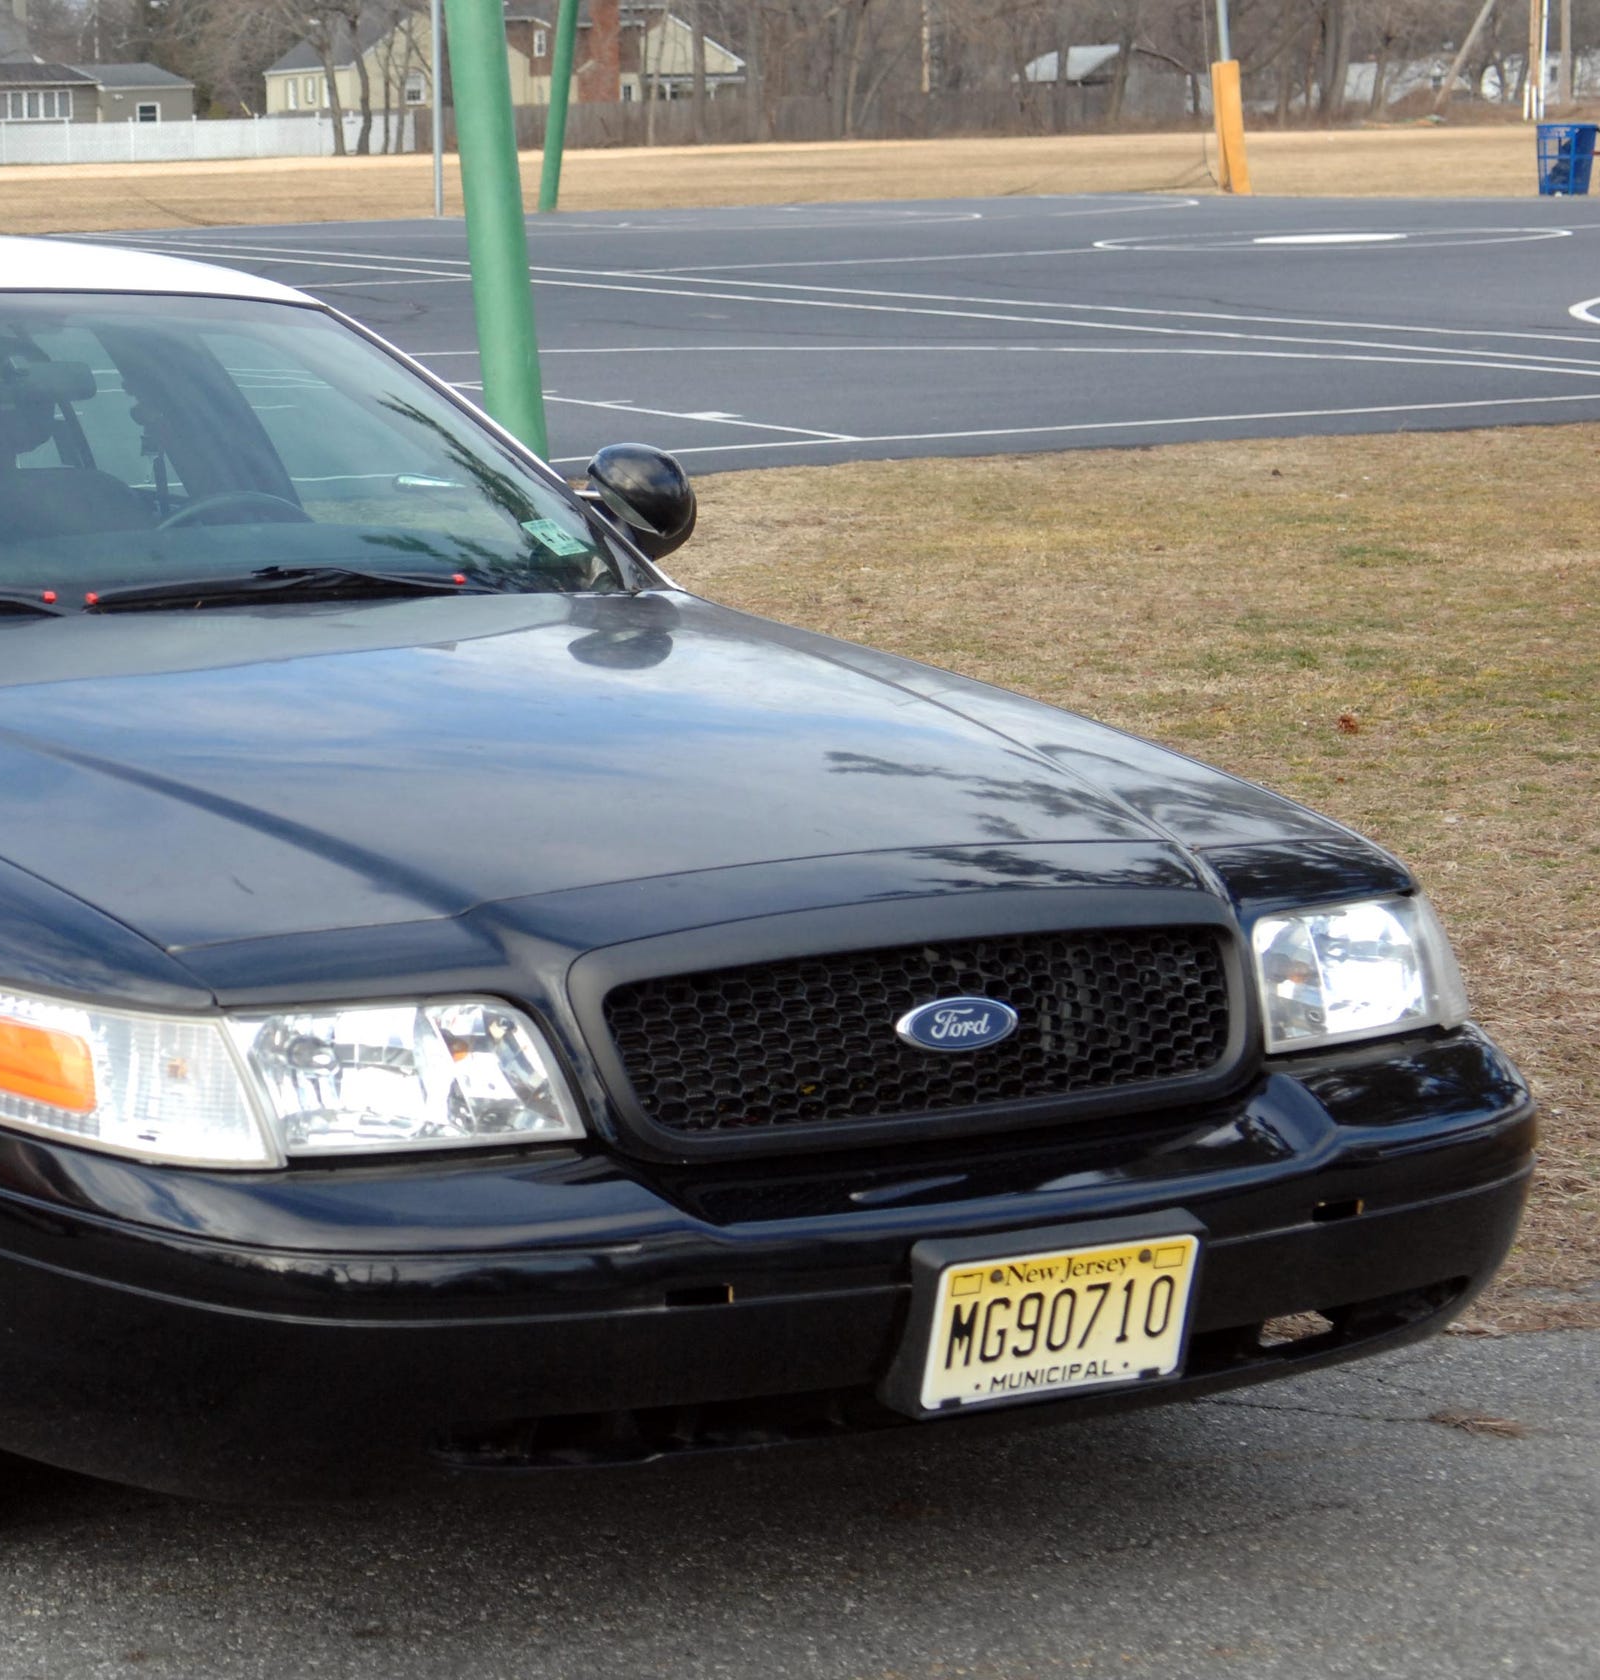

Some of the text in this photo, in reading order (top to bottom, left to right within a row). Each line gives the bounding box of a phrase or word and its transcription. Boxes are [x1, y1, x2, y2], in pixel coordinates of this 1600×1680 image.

[930, 1008, 990, 1039] Ford
[1004, 1254, 1133, 1287] New Jersey
[944, 1275, 1176, 1370] MG90710
[990, 1360, 1115, 1391] MUNICIPAL
